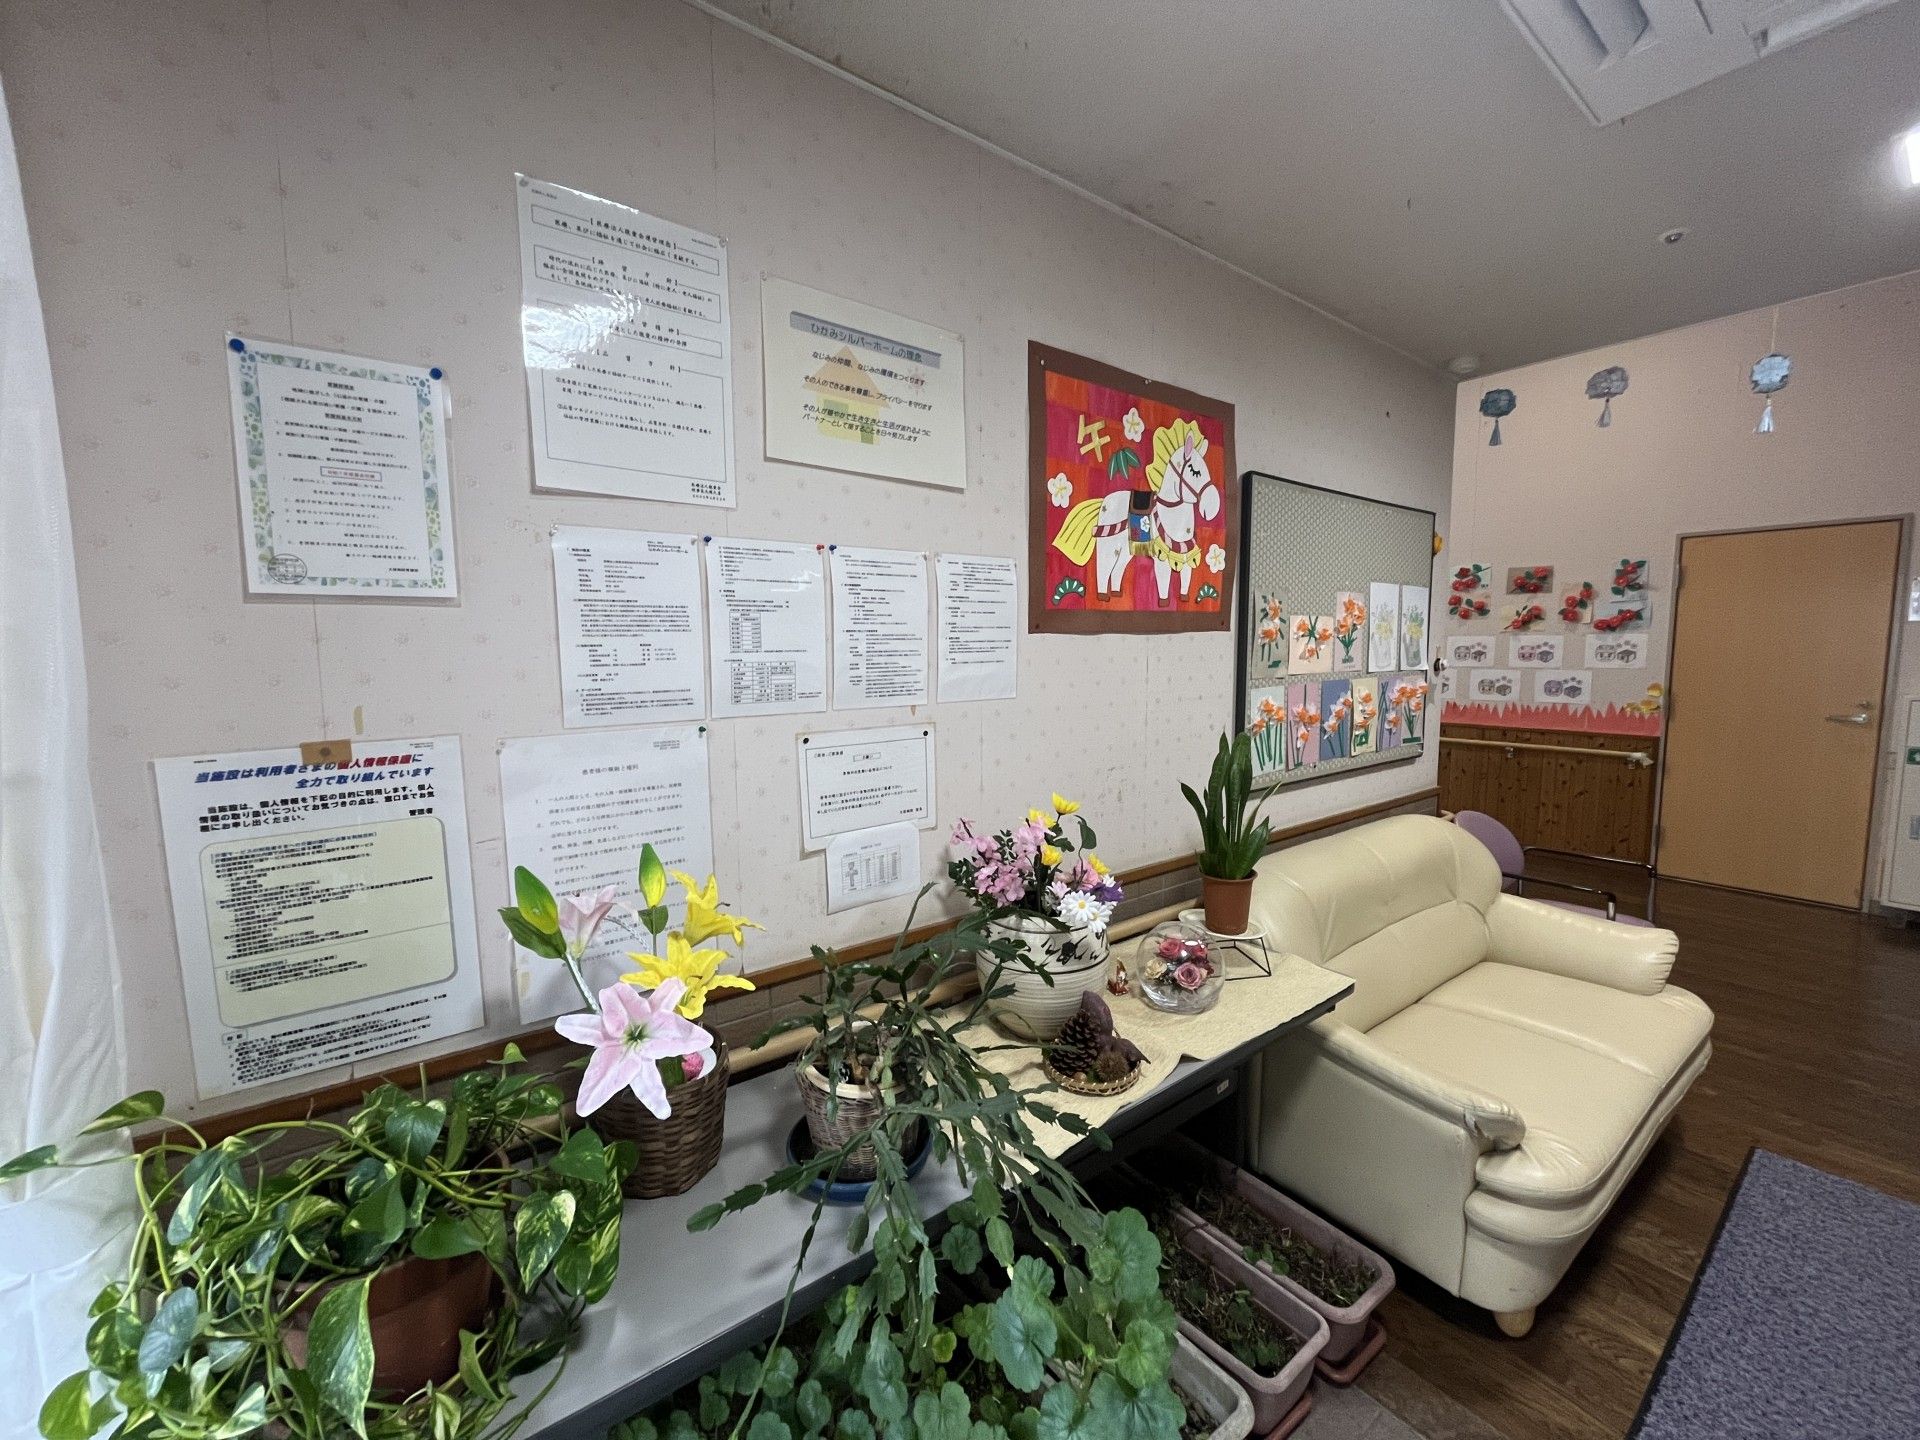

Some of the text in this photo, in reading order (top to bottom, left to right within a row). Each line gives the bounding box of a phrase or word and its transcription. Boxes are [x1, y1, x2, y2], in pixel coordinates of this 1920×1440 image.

[811, 323, 922, 363] ひかみシルバーホームの理念
[811, 350, 926, 387] なじみの仲間、なじみの環境をつくります
[1077, 414, 1111, 463] 午
[295, 766, 435, 790] 全力で取り組んでいます
